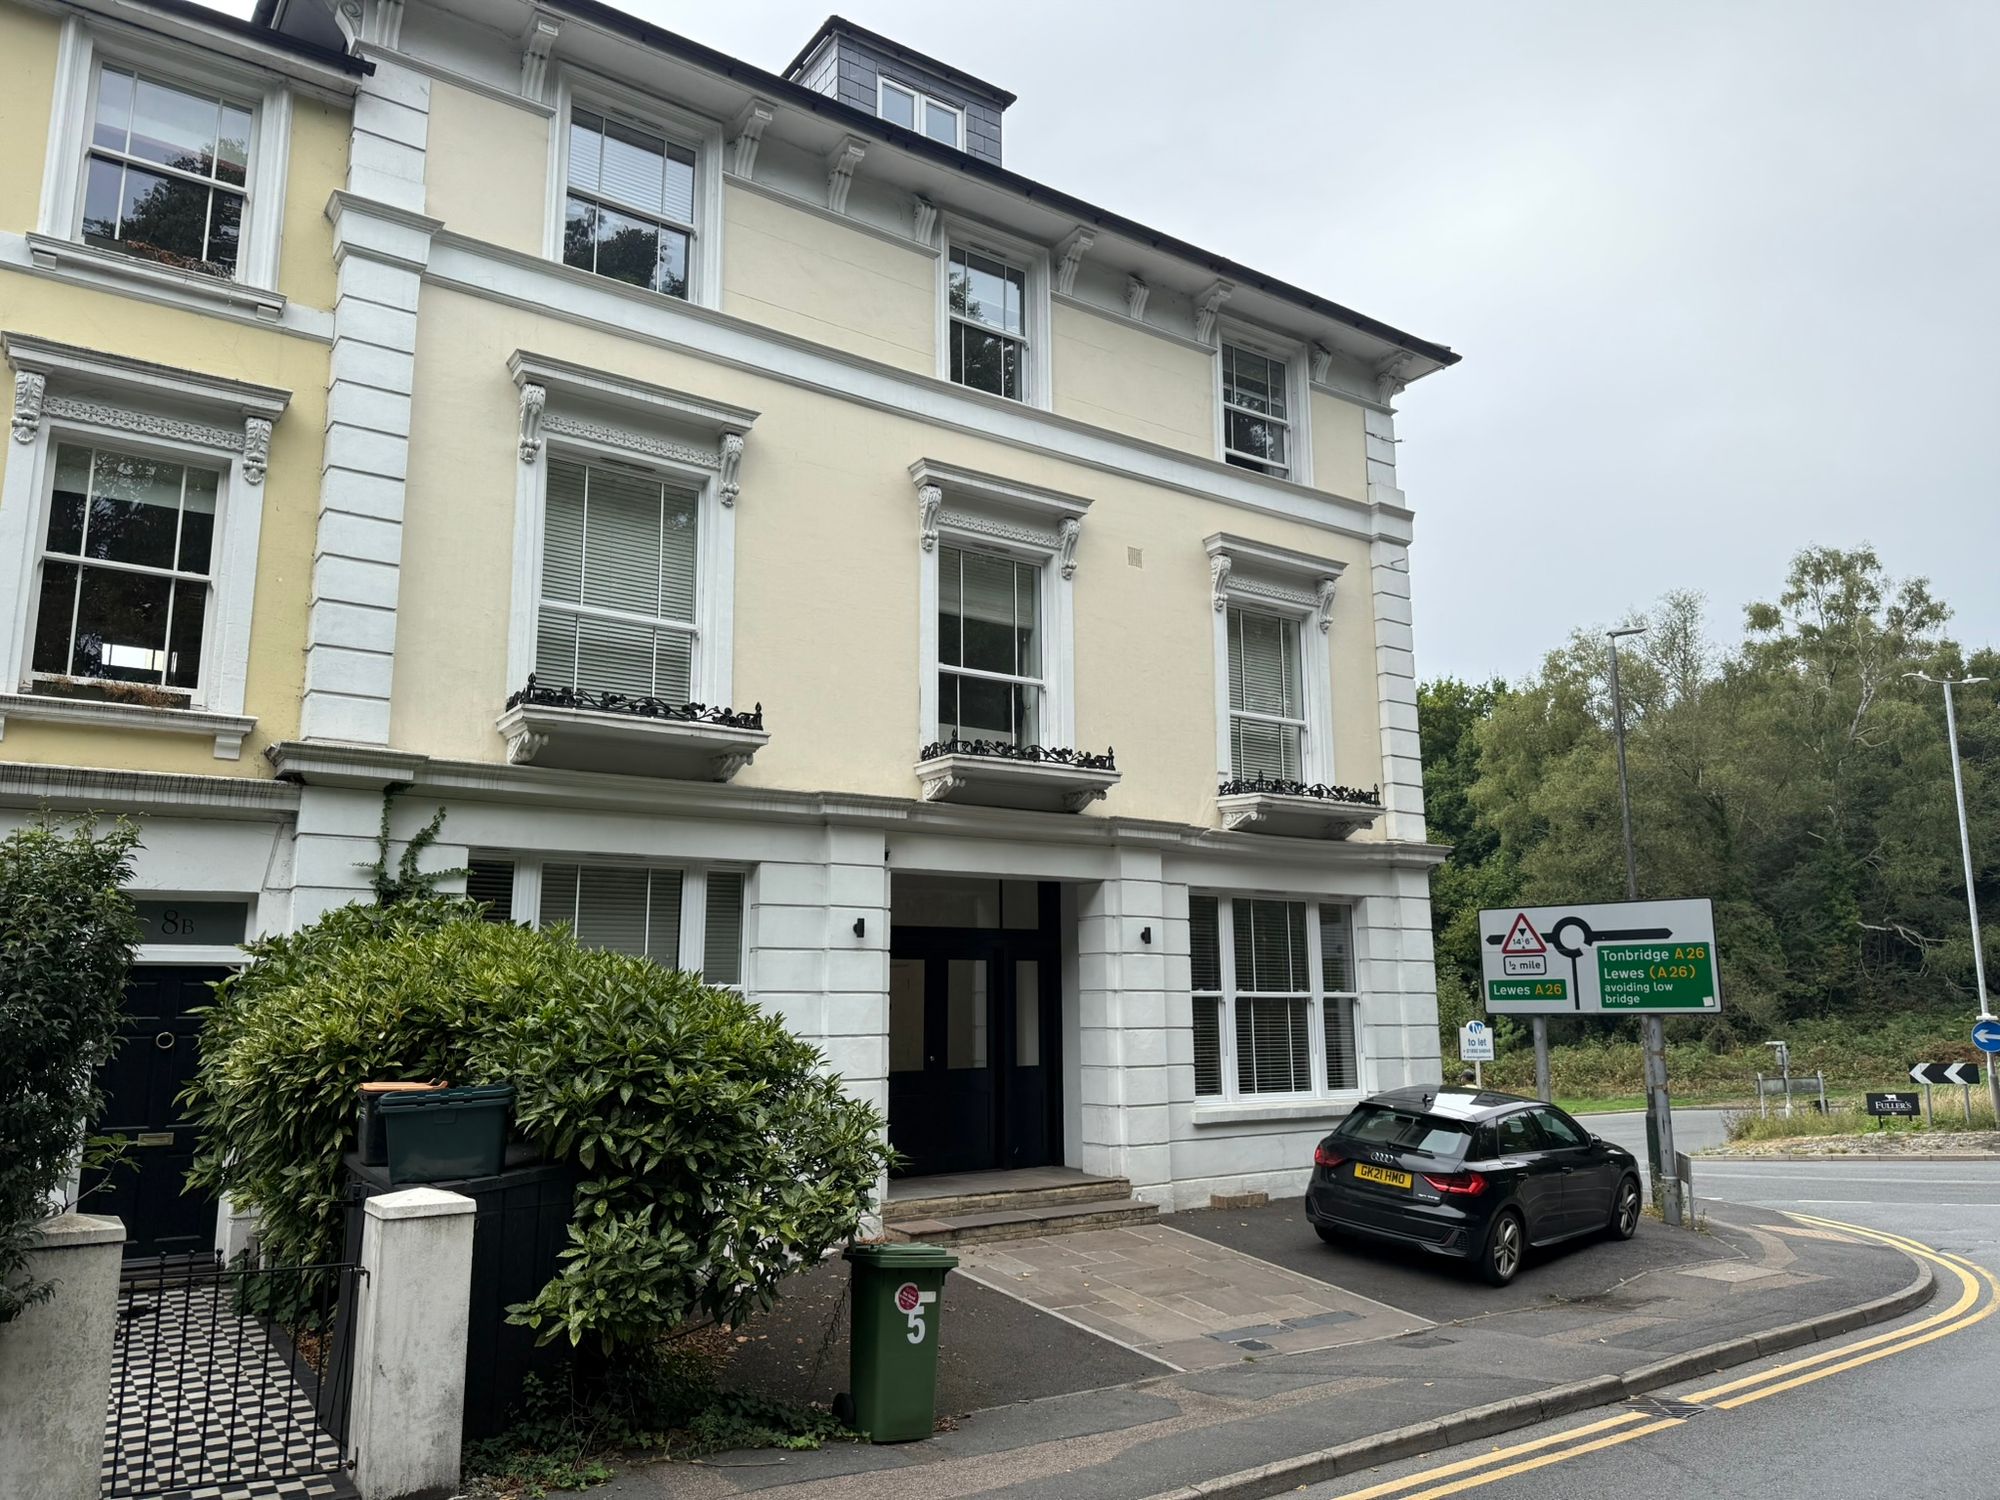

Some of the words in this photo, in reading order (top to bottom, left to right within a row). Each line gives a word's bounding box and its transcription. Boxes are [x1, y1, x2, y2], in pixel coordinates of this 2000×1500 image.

[160, 909, 195, 935] 8B
[1601, 949, 1669, 962] Tonbridge
[1519, 960, 1541, 970] mile
[1604, 967, 1645, 979] Lewes
[1493, 983, 1531, 995] Lewes
[1604, 982, 1650, 993] avoiding
[1653, 982, 1673, 992] low
[1605, 994, 1640, 1005] bridge
[1467, 1038, 1476, 1047] to
[1360, 1165, 1383, 1180] GK21
[1384, 1169, 1406, 1184] HMO
[907, 1305, 925, 1344] 5
